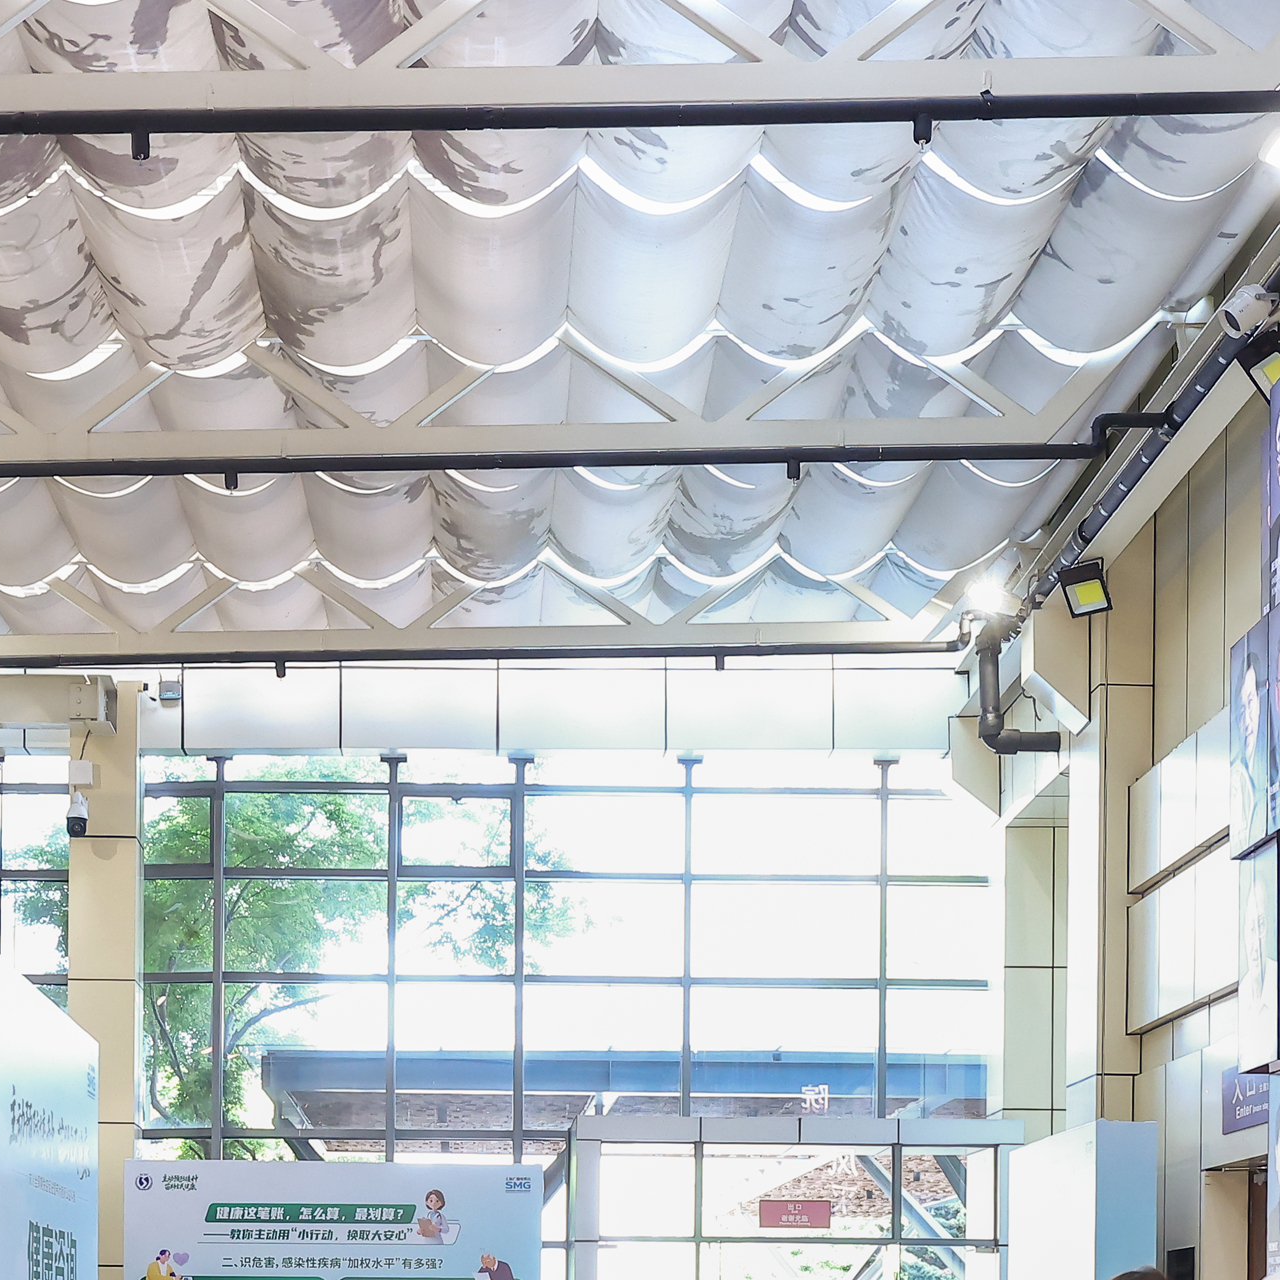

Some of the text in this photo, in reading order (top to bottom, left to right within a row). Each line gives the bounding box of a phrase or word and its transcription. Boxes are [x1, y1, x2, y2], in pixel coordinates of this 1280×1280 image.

[1232, 1078, 1256, 1104] 入口
[1235, 1105, 1252, 1119] Enter
[505, 1181, 531, 1189] SMG
